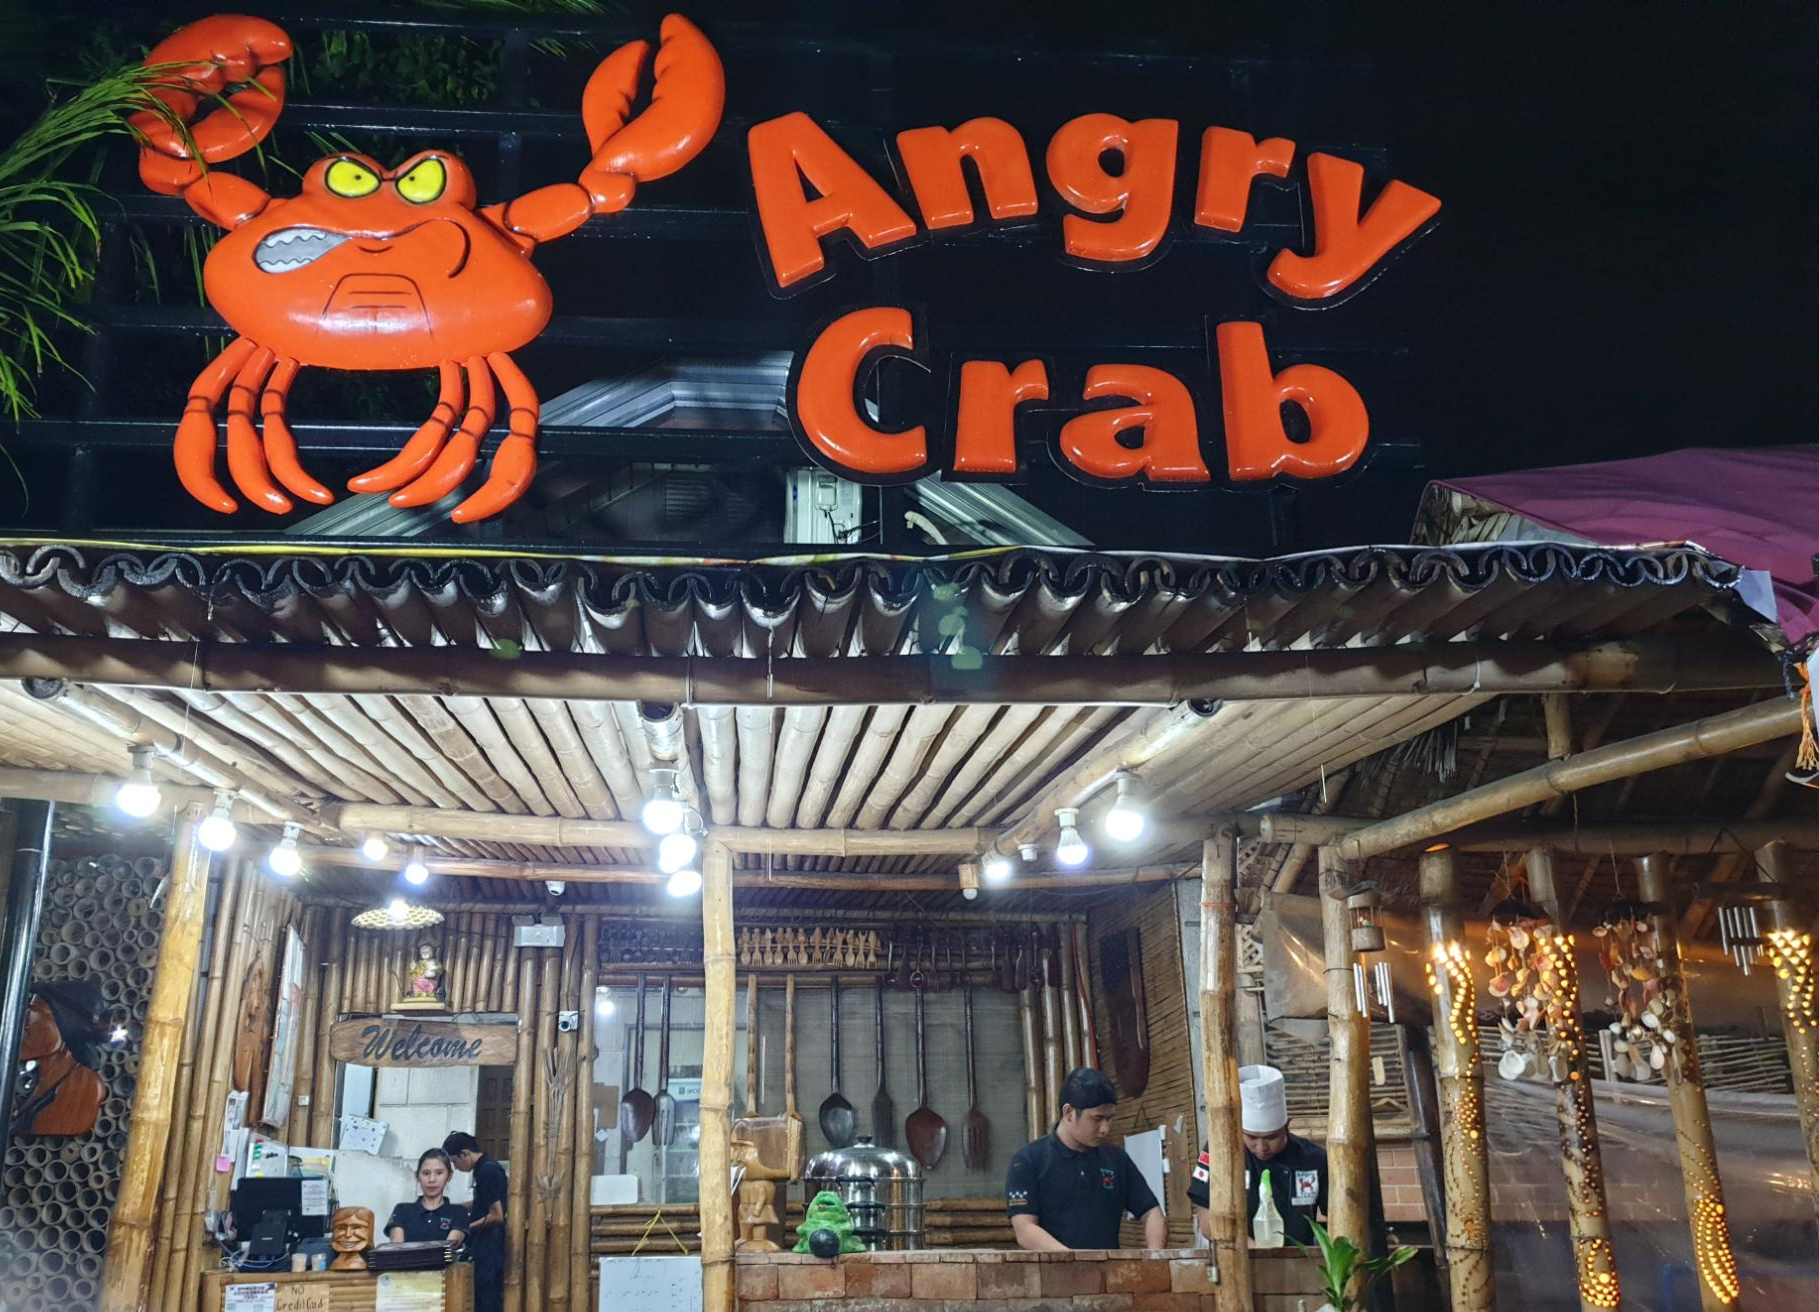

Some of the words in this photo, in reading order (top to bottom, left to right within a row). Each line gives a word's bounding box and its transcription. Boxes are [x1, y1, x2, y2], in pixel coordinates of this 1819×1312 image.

[747, 111, 1442, 299] Angry
[797, 307, 1370, 482] Crab
[361, 1024, 483, 1061] Welcome
[291, 1285, 305, 1295] NO
